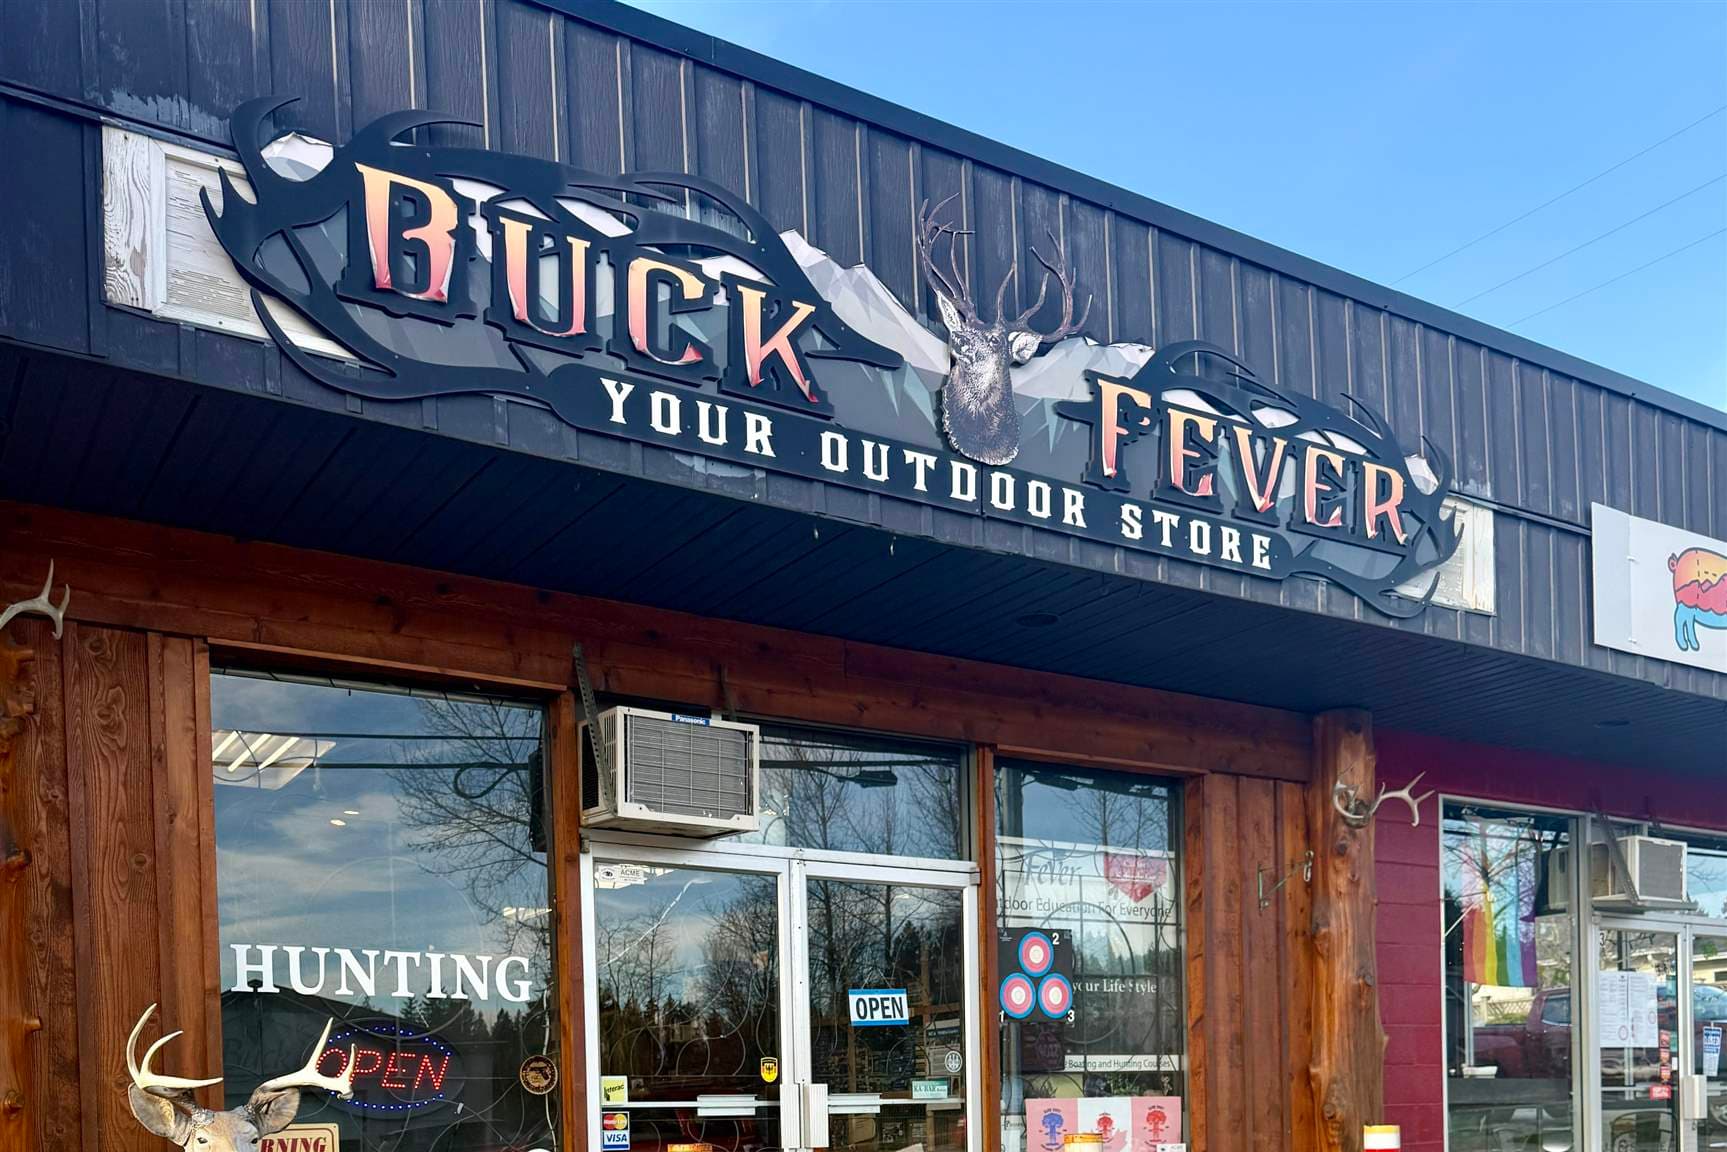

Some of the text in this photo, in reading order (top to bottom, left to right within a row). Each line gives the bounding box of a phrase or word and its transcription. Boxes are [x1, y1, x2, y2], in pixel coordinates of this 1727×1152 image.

[354, 161, 1408, 545] BUCK FEVER
[600, 377, 1272, 571] YOUR OUTDOOR STORE
[1002, 895, 1033, 911] door
[1052, 932, 1060, 945] 2
[230, 943, 533, 1002] HUNTING
[1103, 979, 1126, 993] Life
[856, 996, 905, 1020] OPEN
[1067, 1009, 1075, 1022] 3
[999, 1011, 1005, 1022] 1
[315, 1047, 450, 1091] OPEN
[1143, 1059, 1170, 1069] Couses
[606, 1133, 628, 1143] VISA
